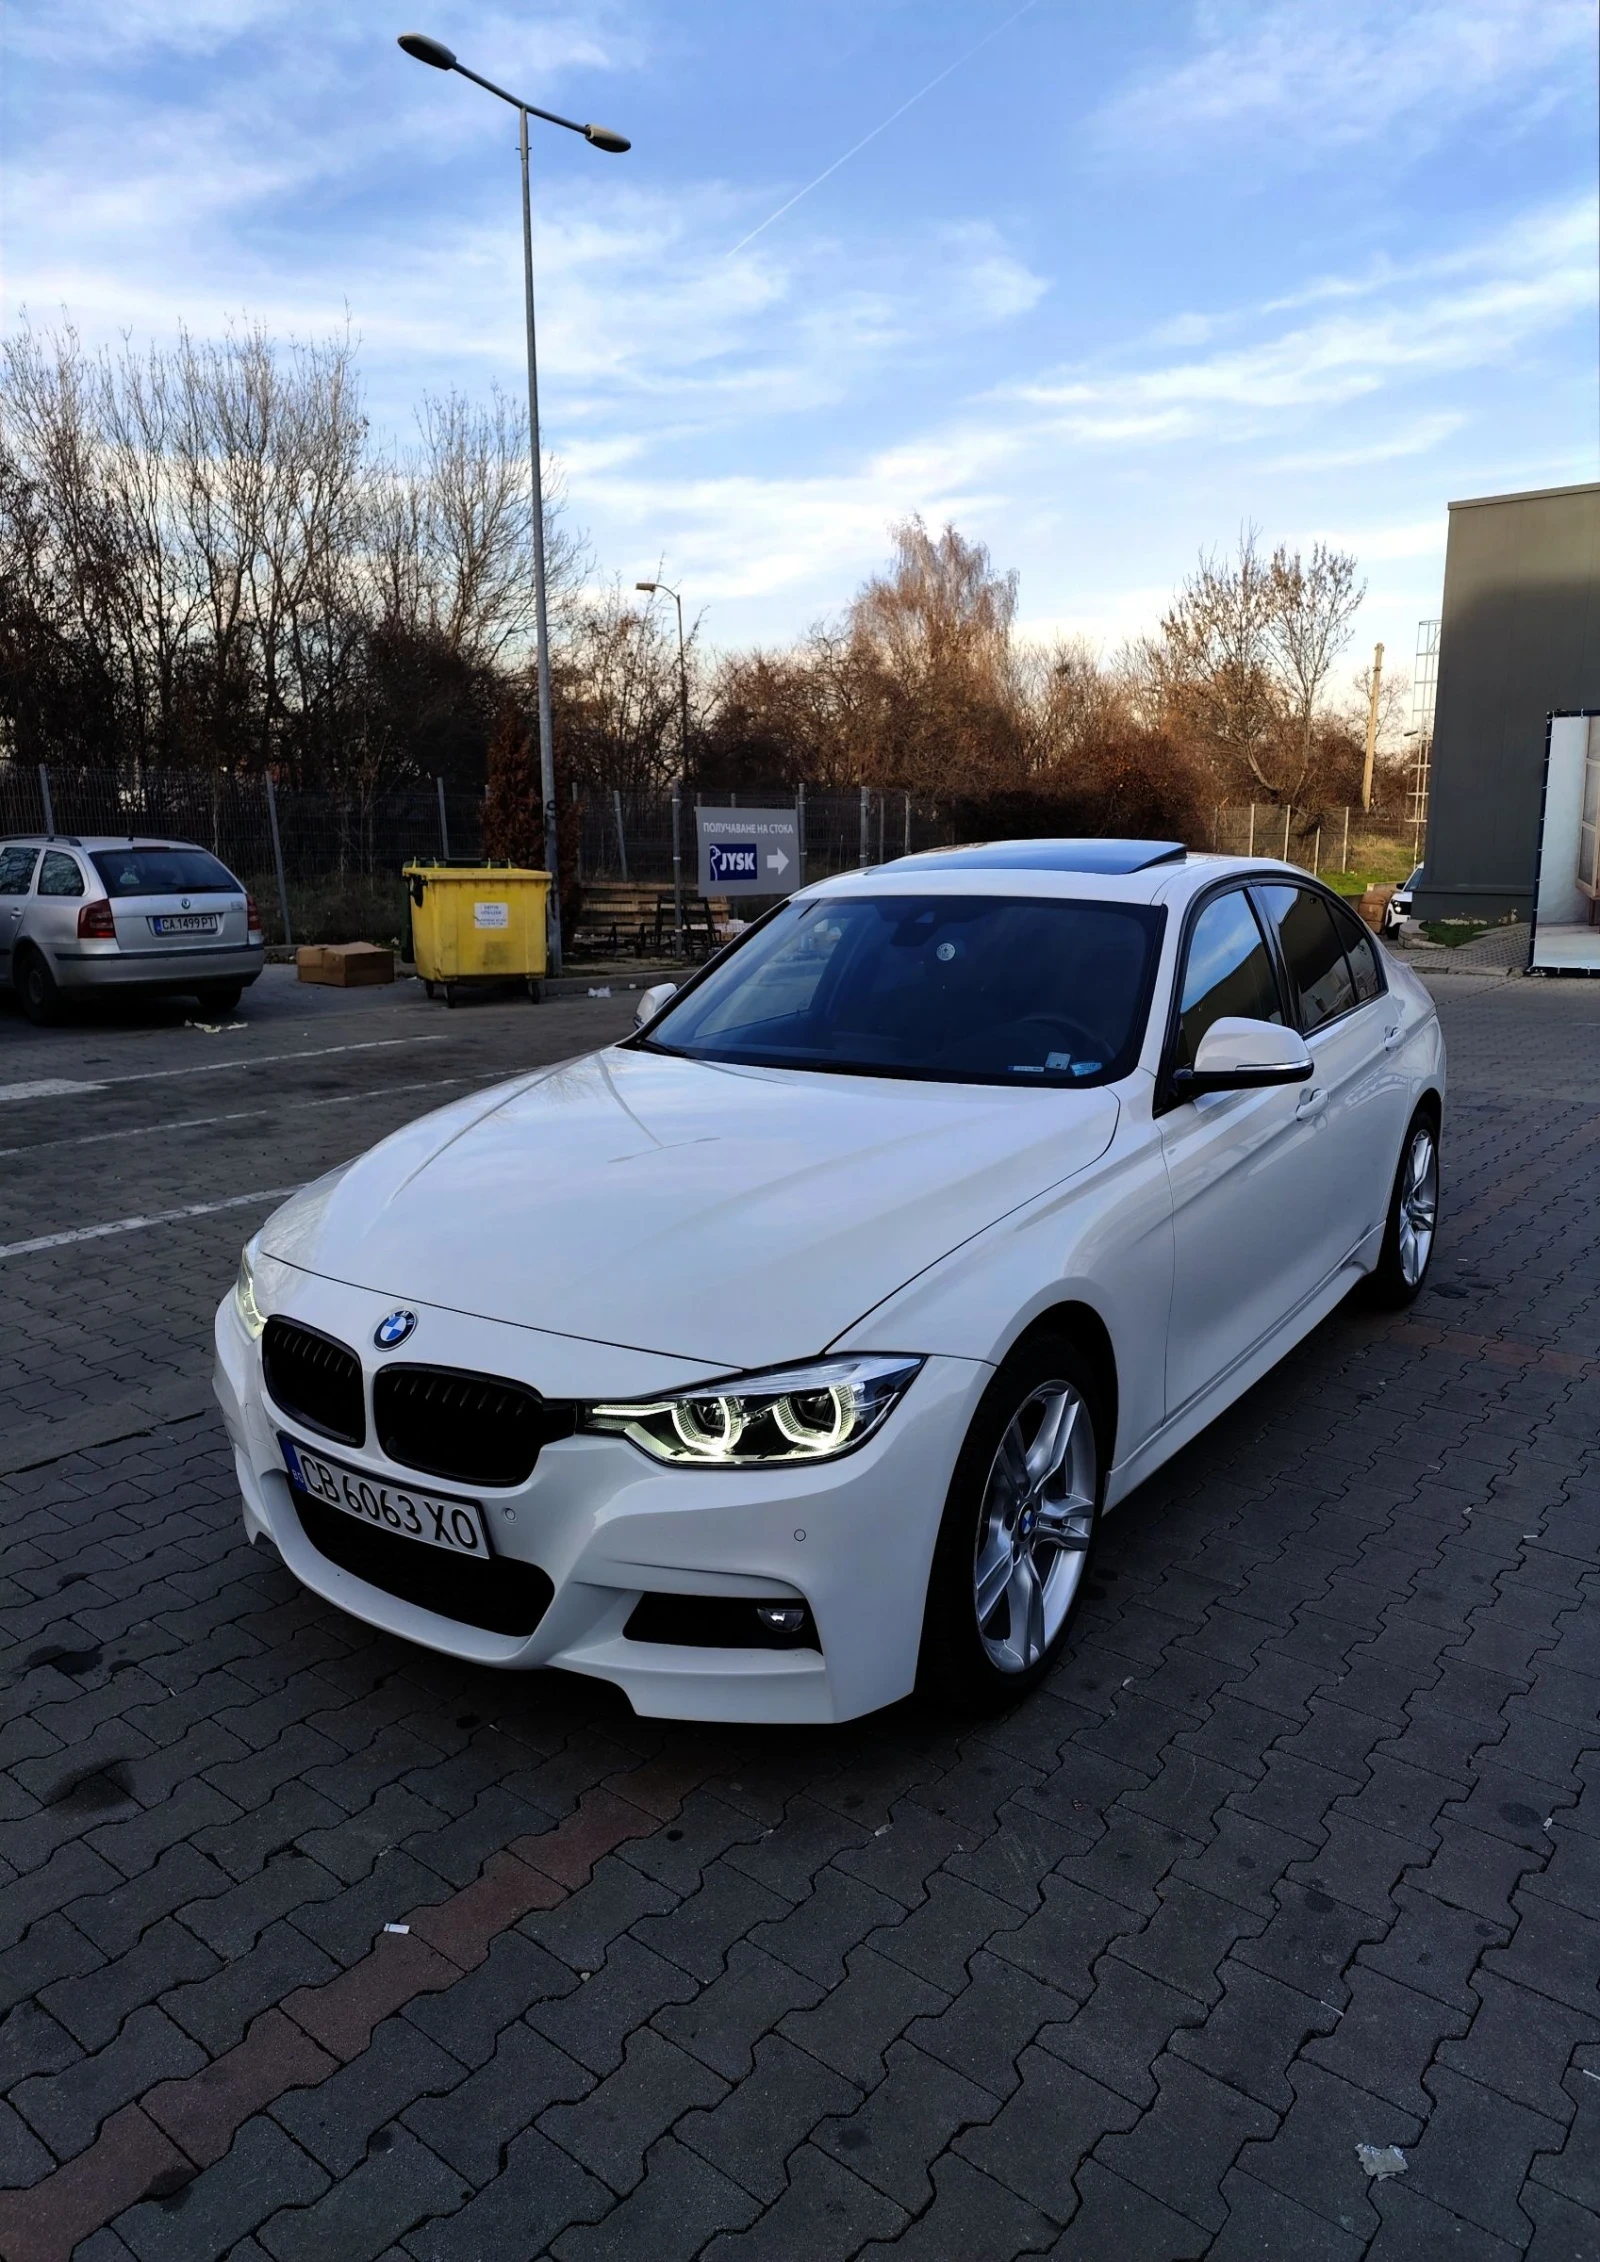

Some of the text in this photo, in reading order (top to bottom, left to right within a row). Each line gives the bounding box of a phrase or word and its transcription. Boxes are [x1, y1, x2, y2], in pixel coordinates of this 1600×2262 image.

[703, 822, 793, 834] ПОЛУЧАВАНЕ НА СТОКА
[720, 852, 755, 871] JYSK
[343, 1474, 422, 1535] 6063
